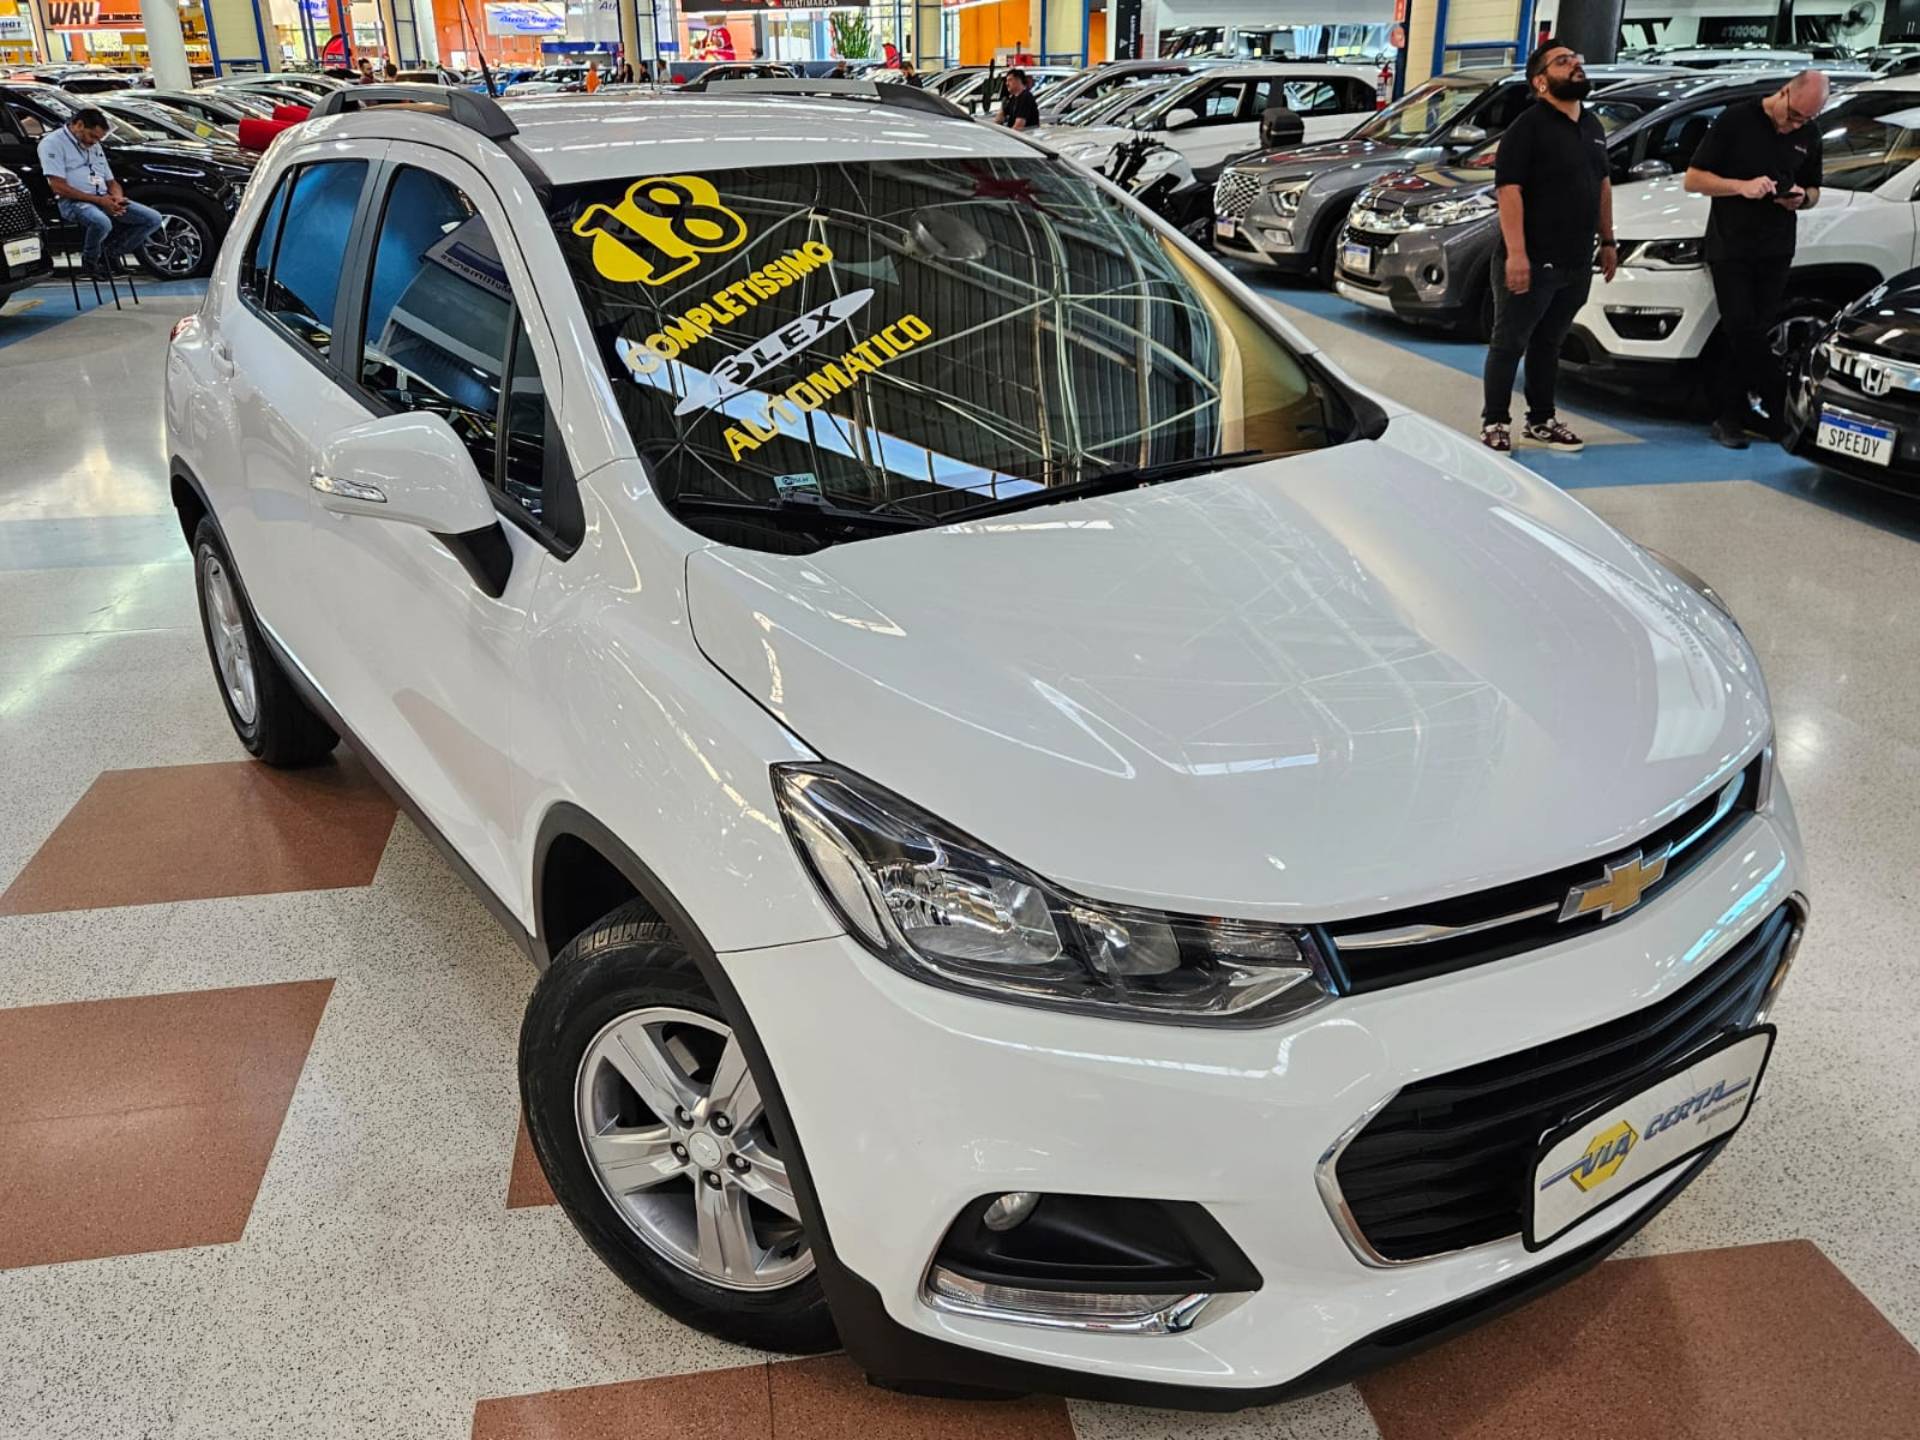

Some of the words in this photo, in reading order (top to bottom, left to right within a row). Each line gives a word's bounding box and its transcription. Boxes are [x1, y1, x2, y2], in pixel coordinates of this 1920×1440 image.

[48, 2, 95, 25] WAY
[575, 178, 744, 284] 18
[624, 240, 833, 374] COMPLETISSIMO
[722, 314, 932, 461] AUTOMATICO
[1828, 428, 1880, 458] SPEEDY
[1565, 1131, 1631, 1180] VIA
[1643, 1079, 1729, 1140] CERTA
